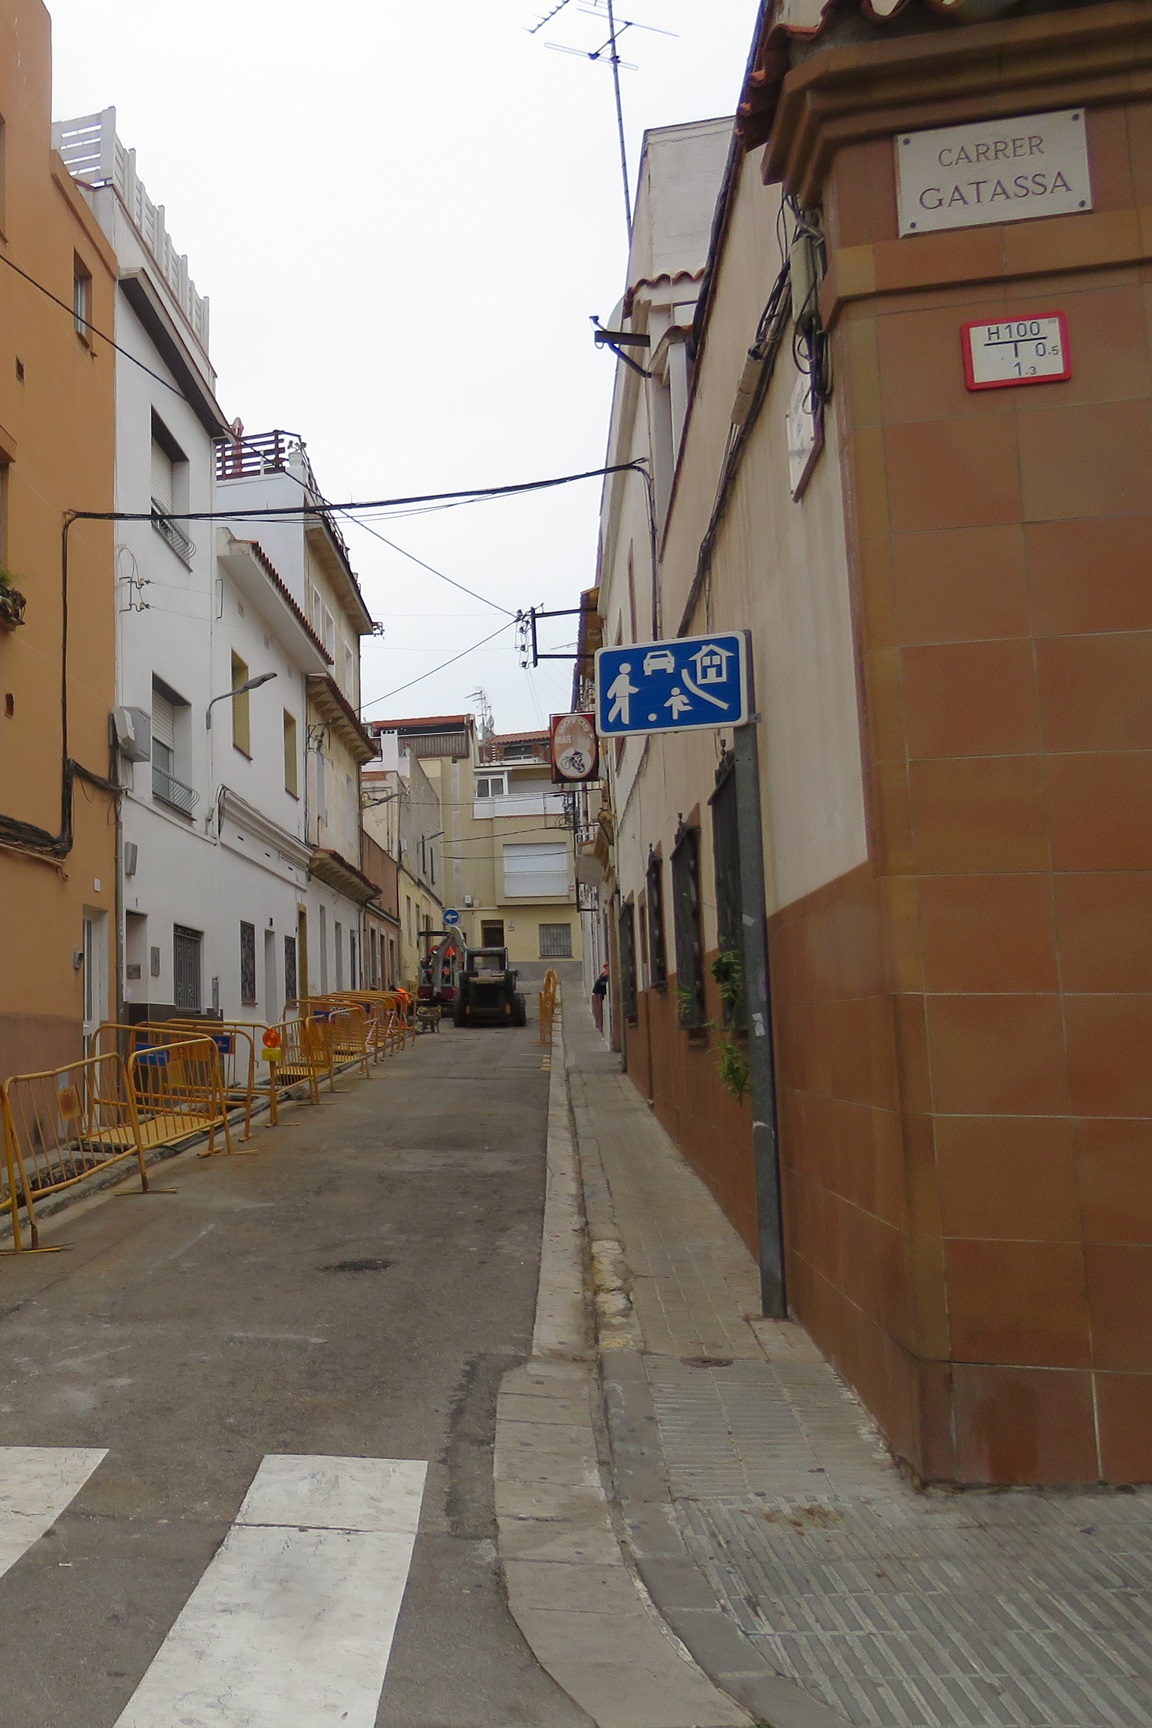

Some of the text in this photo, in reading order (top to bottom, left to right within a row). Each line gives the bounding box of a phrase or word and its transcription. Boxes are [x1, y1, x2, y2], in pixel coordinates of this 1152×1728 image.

[938, 136, 1045, 167] CARRER
[920, 171, 1072, 210] GATASSA
[988, 321, 1040, 340] H100
[559, 717, 590, 733] MOTOS
